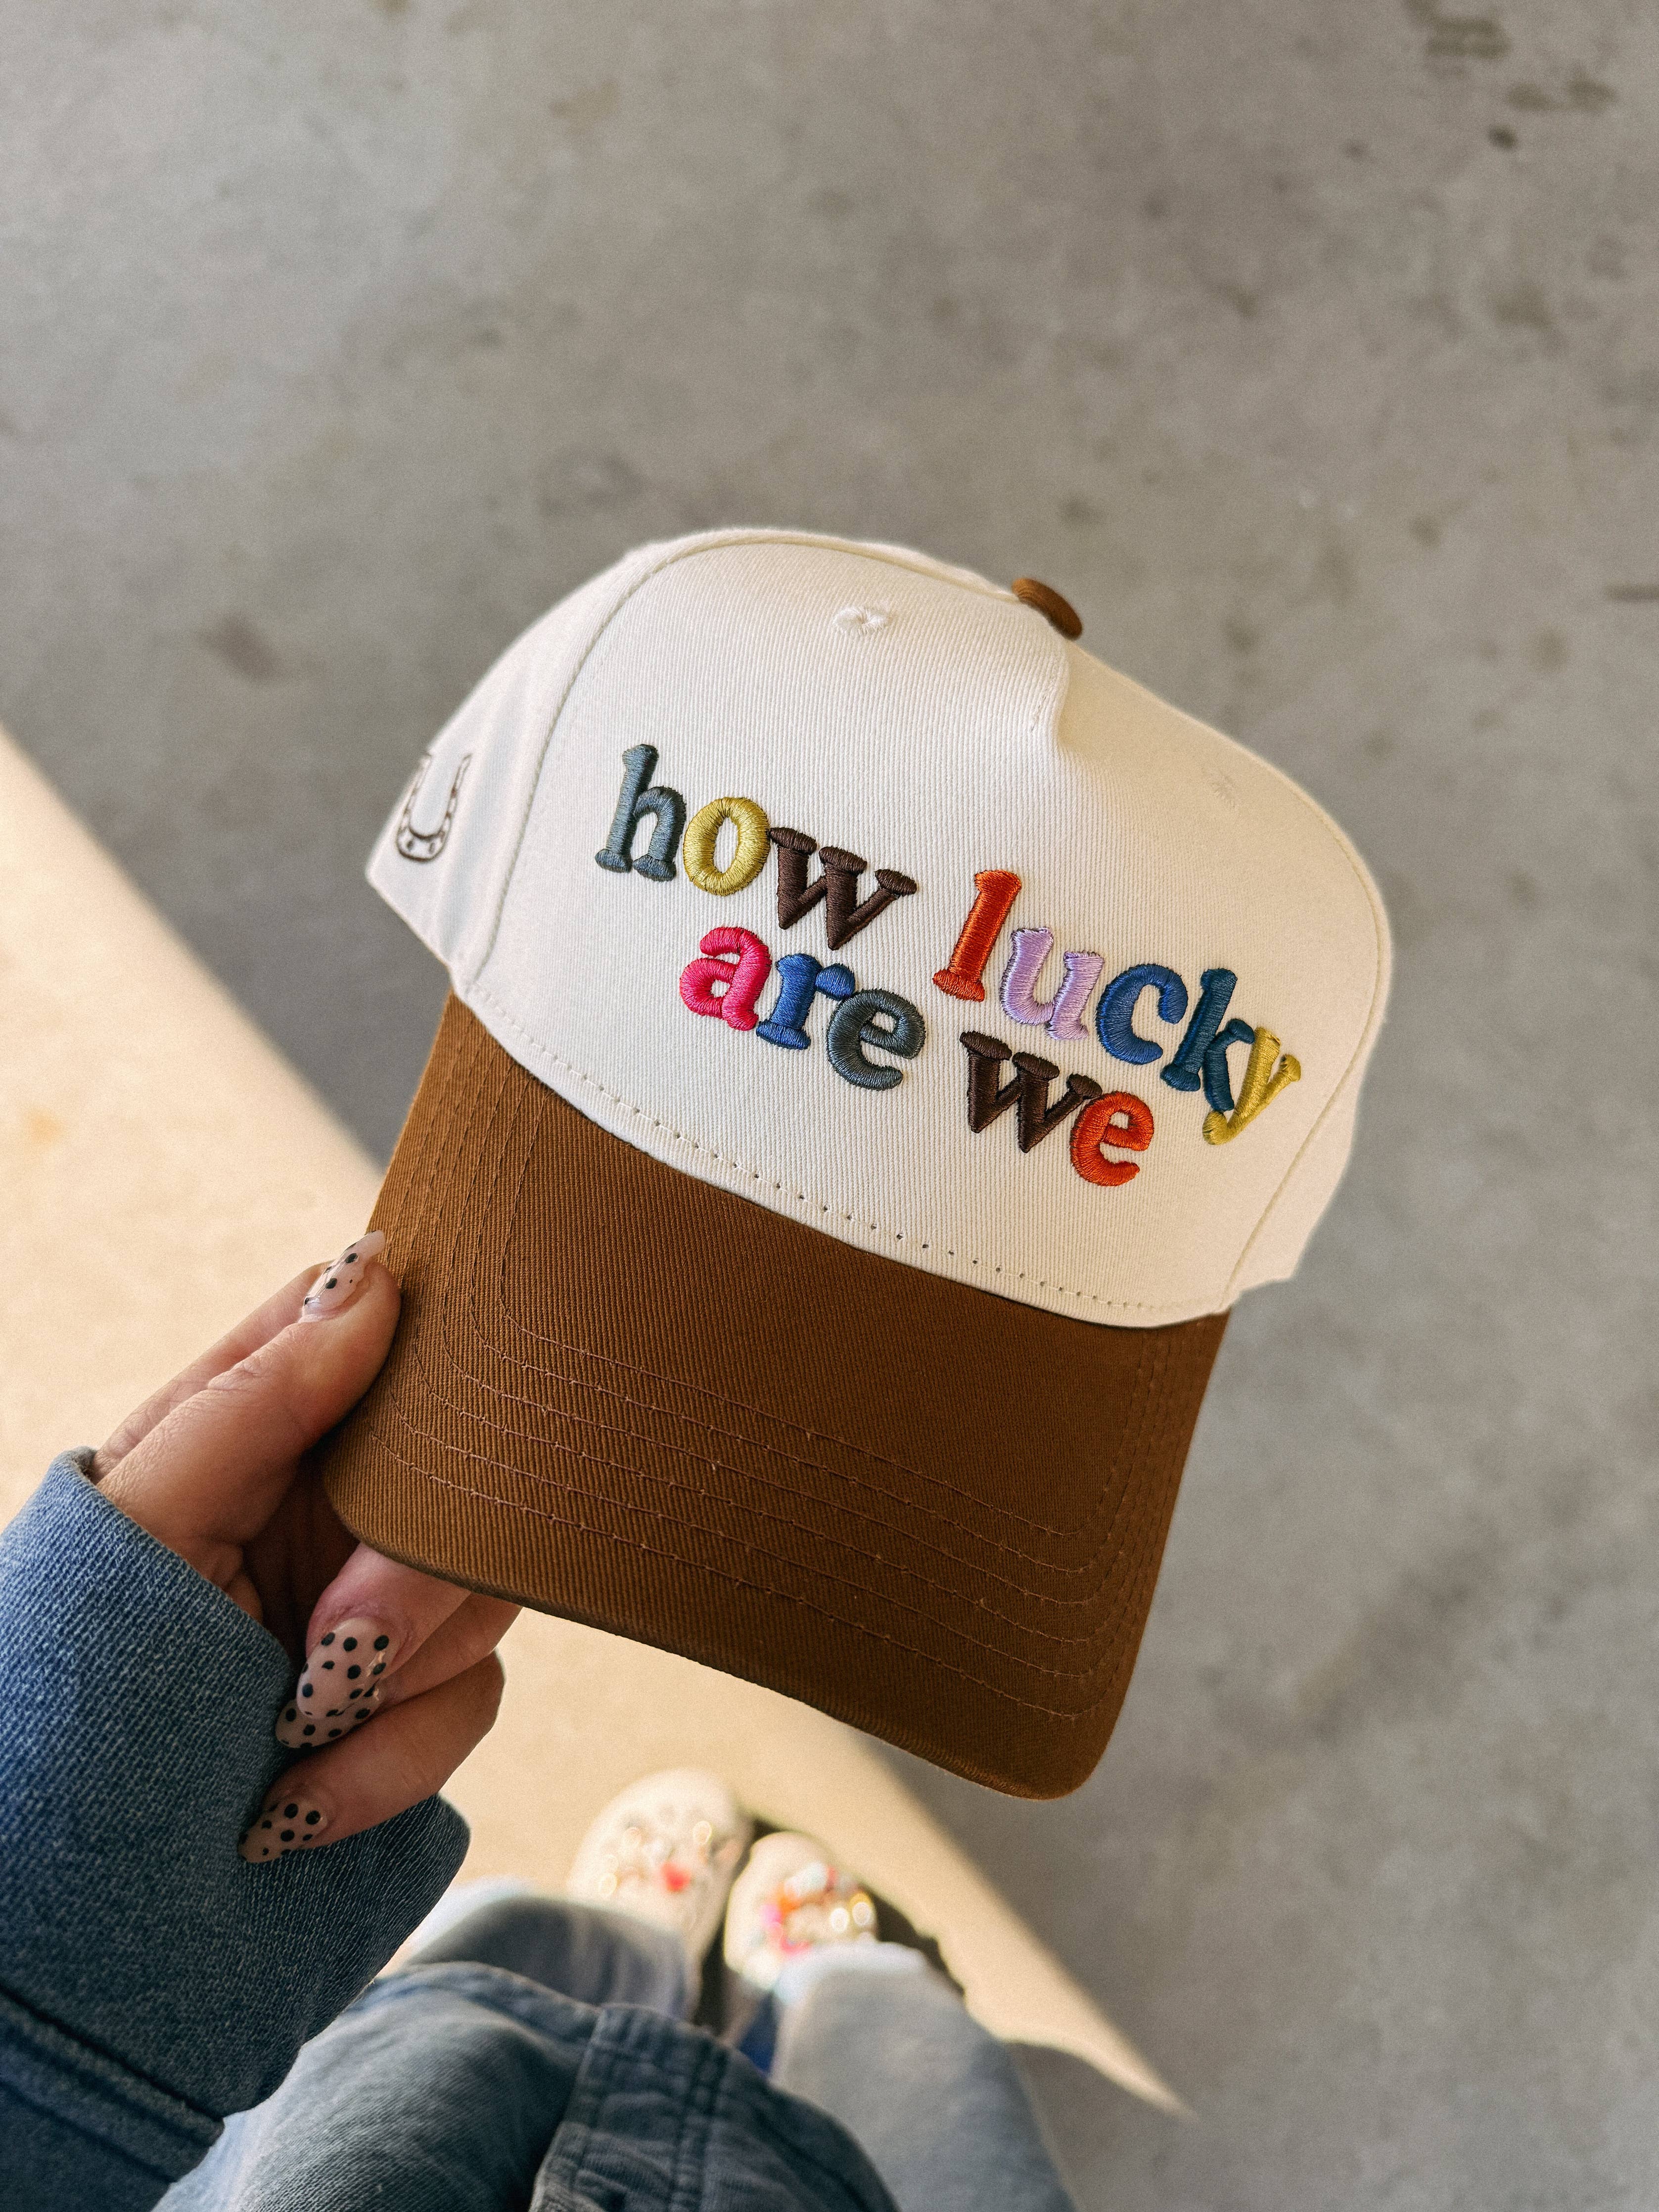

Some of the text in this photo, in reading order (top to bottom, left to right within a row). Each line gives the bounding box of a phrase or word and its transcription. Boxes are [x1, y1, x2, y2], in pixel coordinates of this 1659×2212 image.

[595, 743, 1301, 1145] how lucky
[679, 926, 1154, 1187] are we
